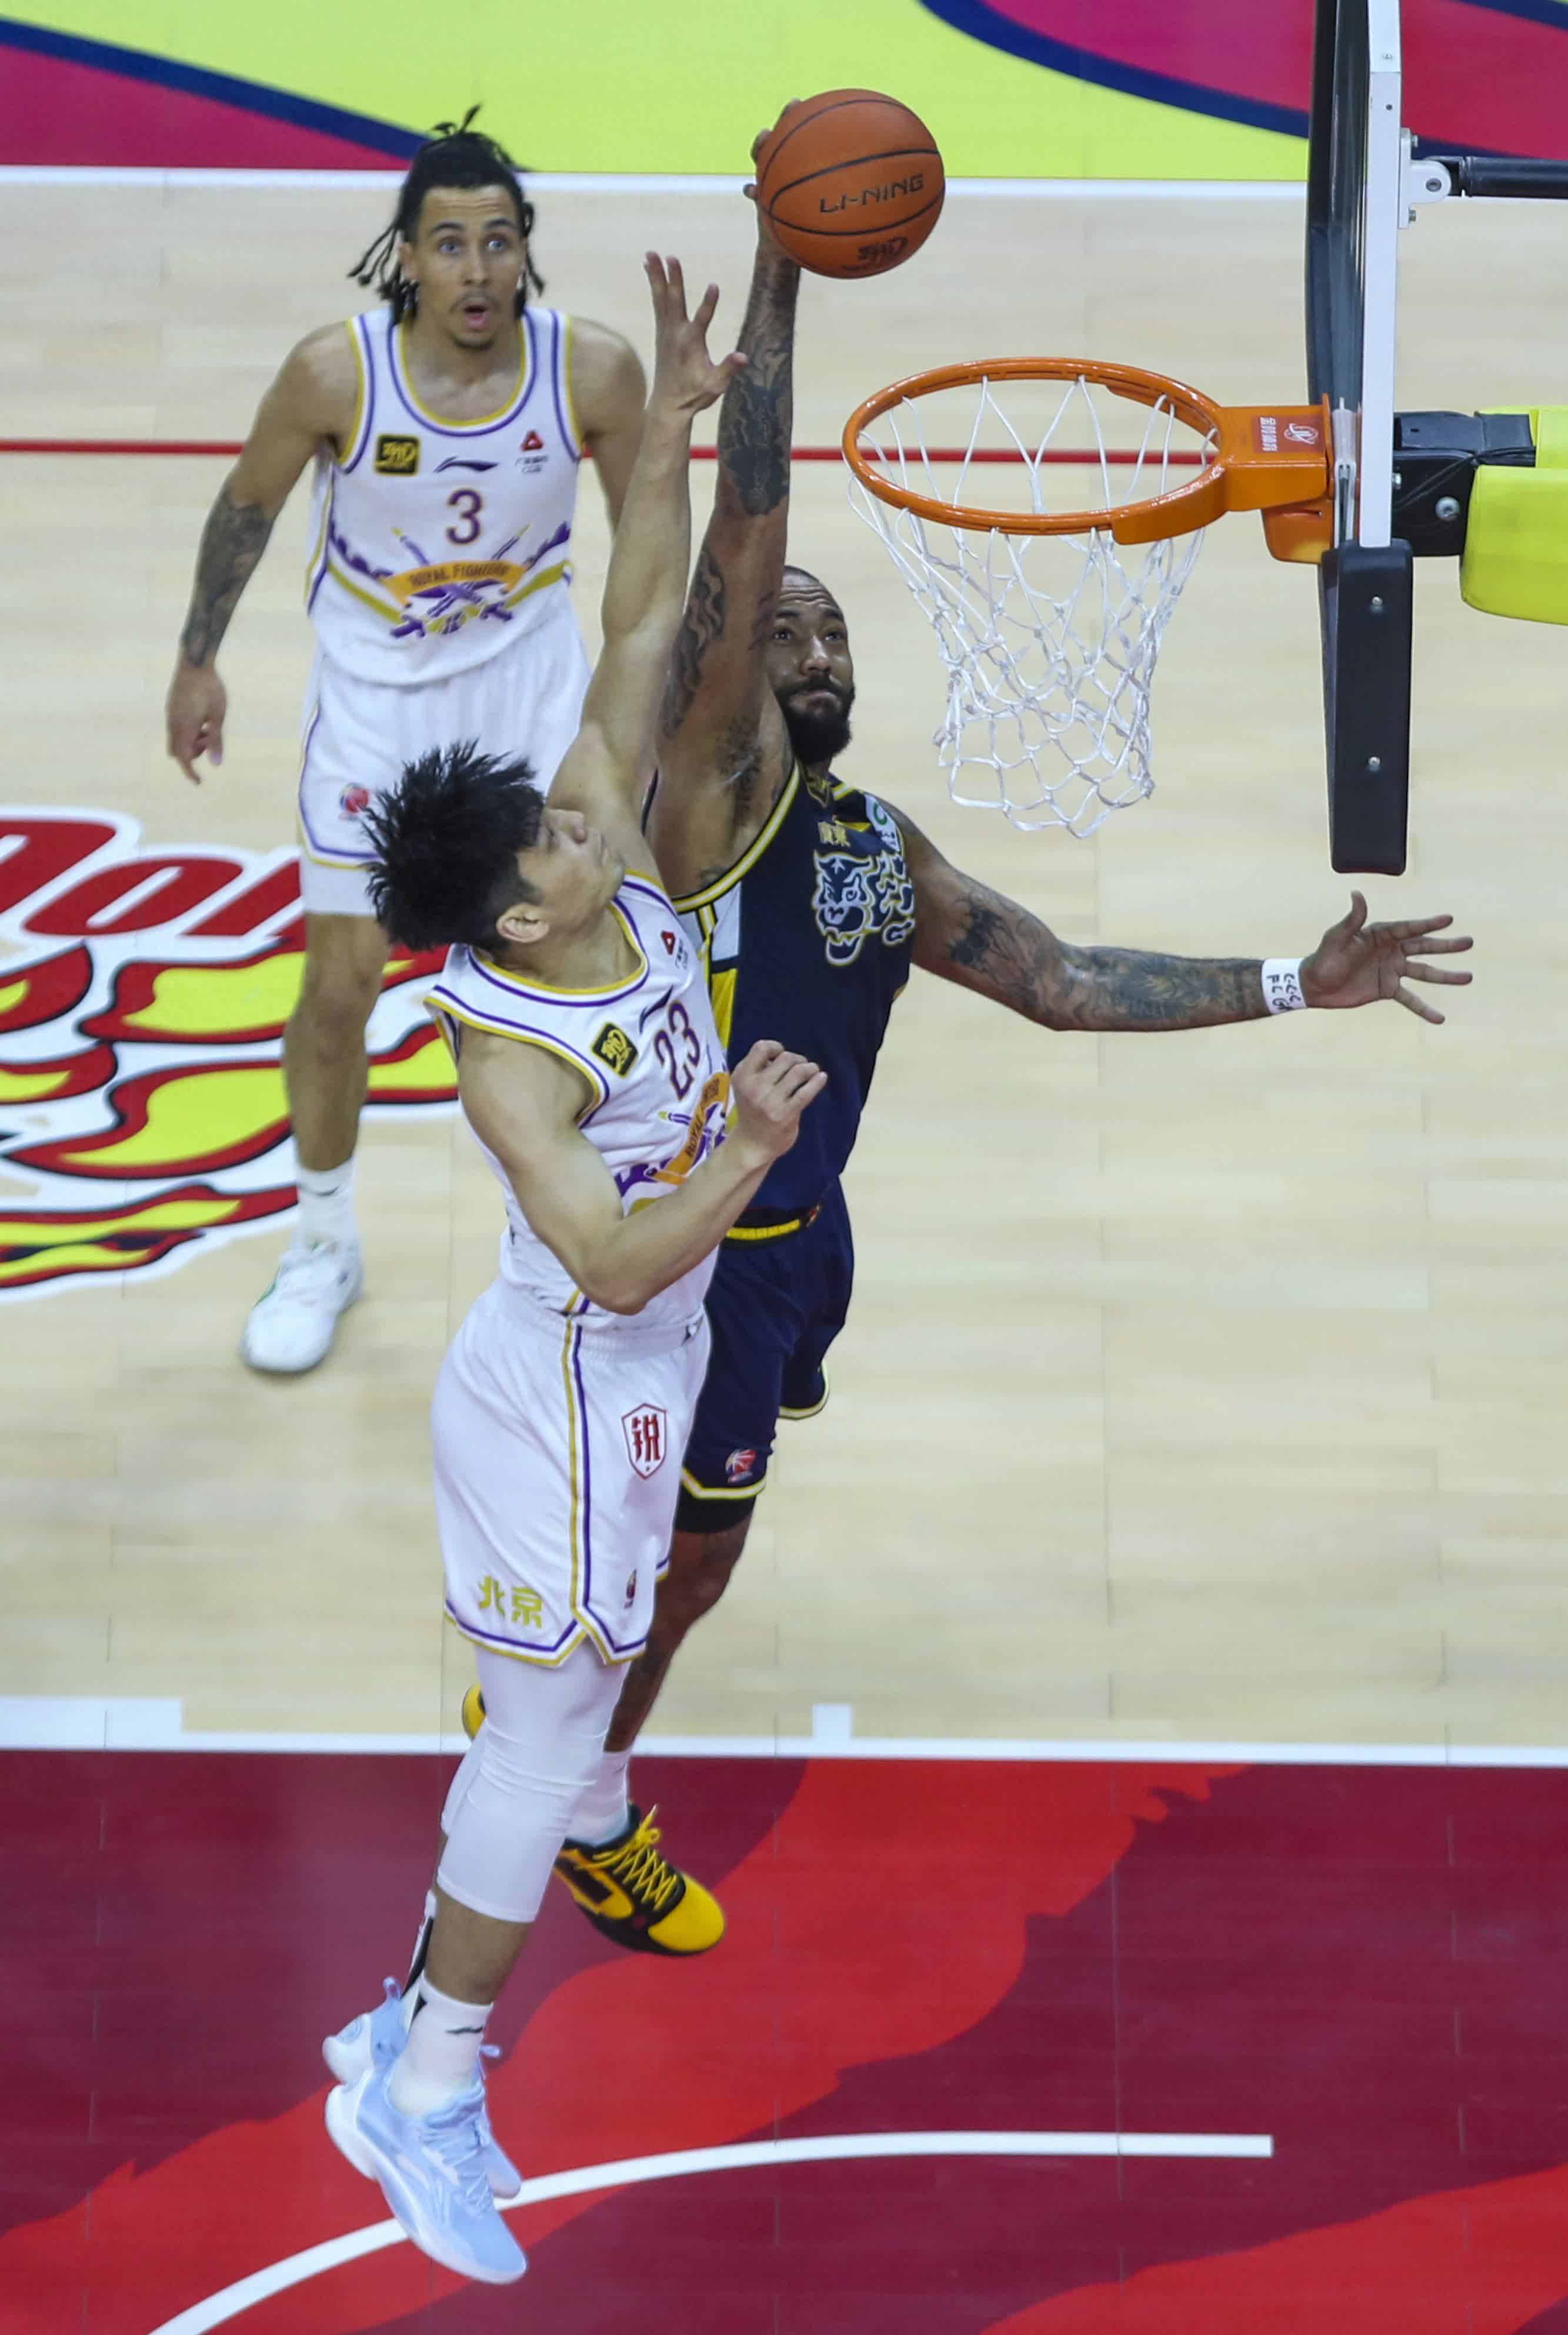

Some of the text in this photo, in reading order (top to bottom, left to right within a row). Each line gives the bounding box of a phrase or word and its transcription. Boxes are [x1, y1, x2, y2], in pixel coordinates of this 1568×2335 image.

[819, 174, 924, 214] LI-NING
[446, 488, 484, 546] 3
[653, 1000, 700, 1102] 23
[478, 1575, 542, 1629] 北京
